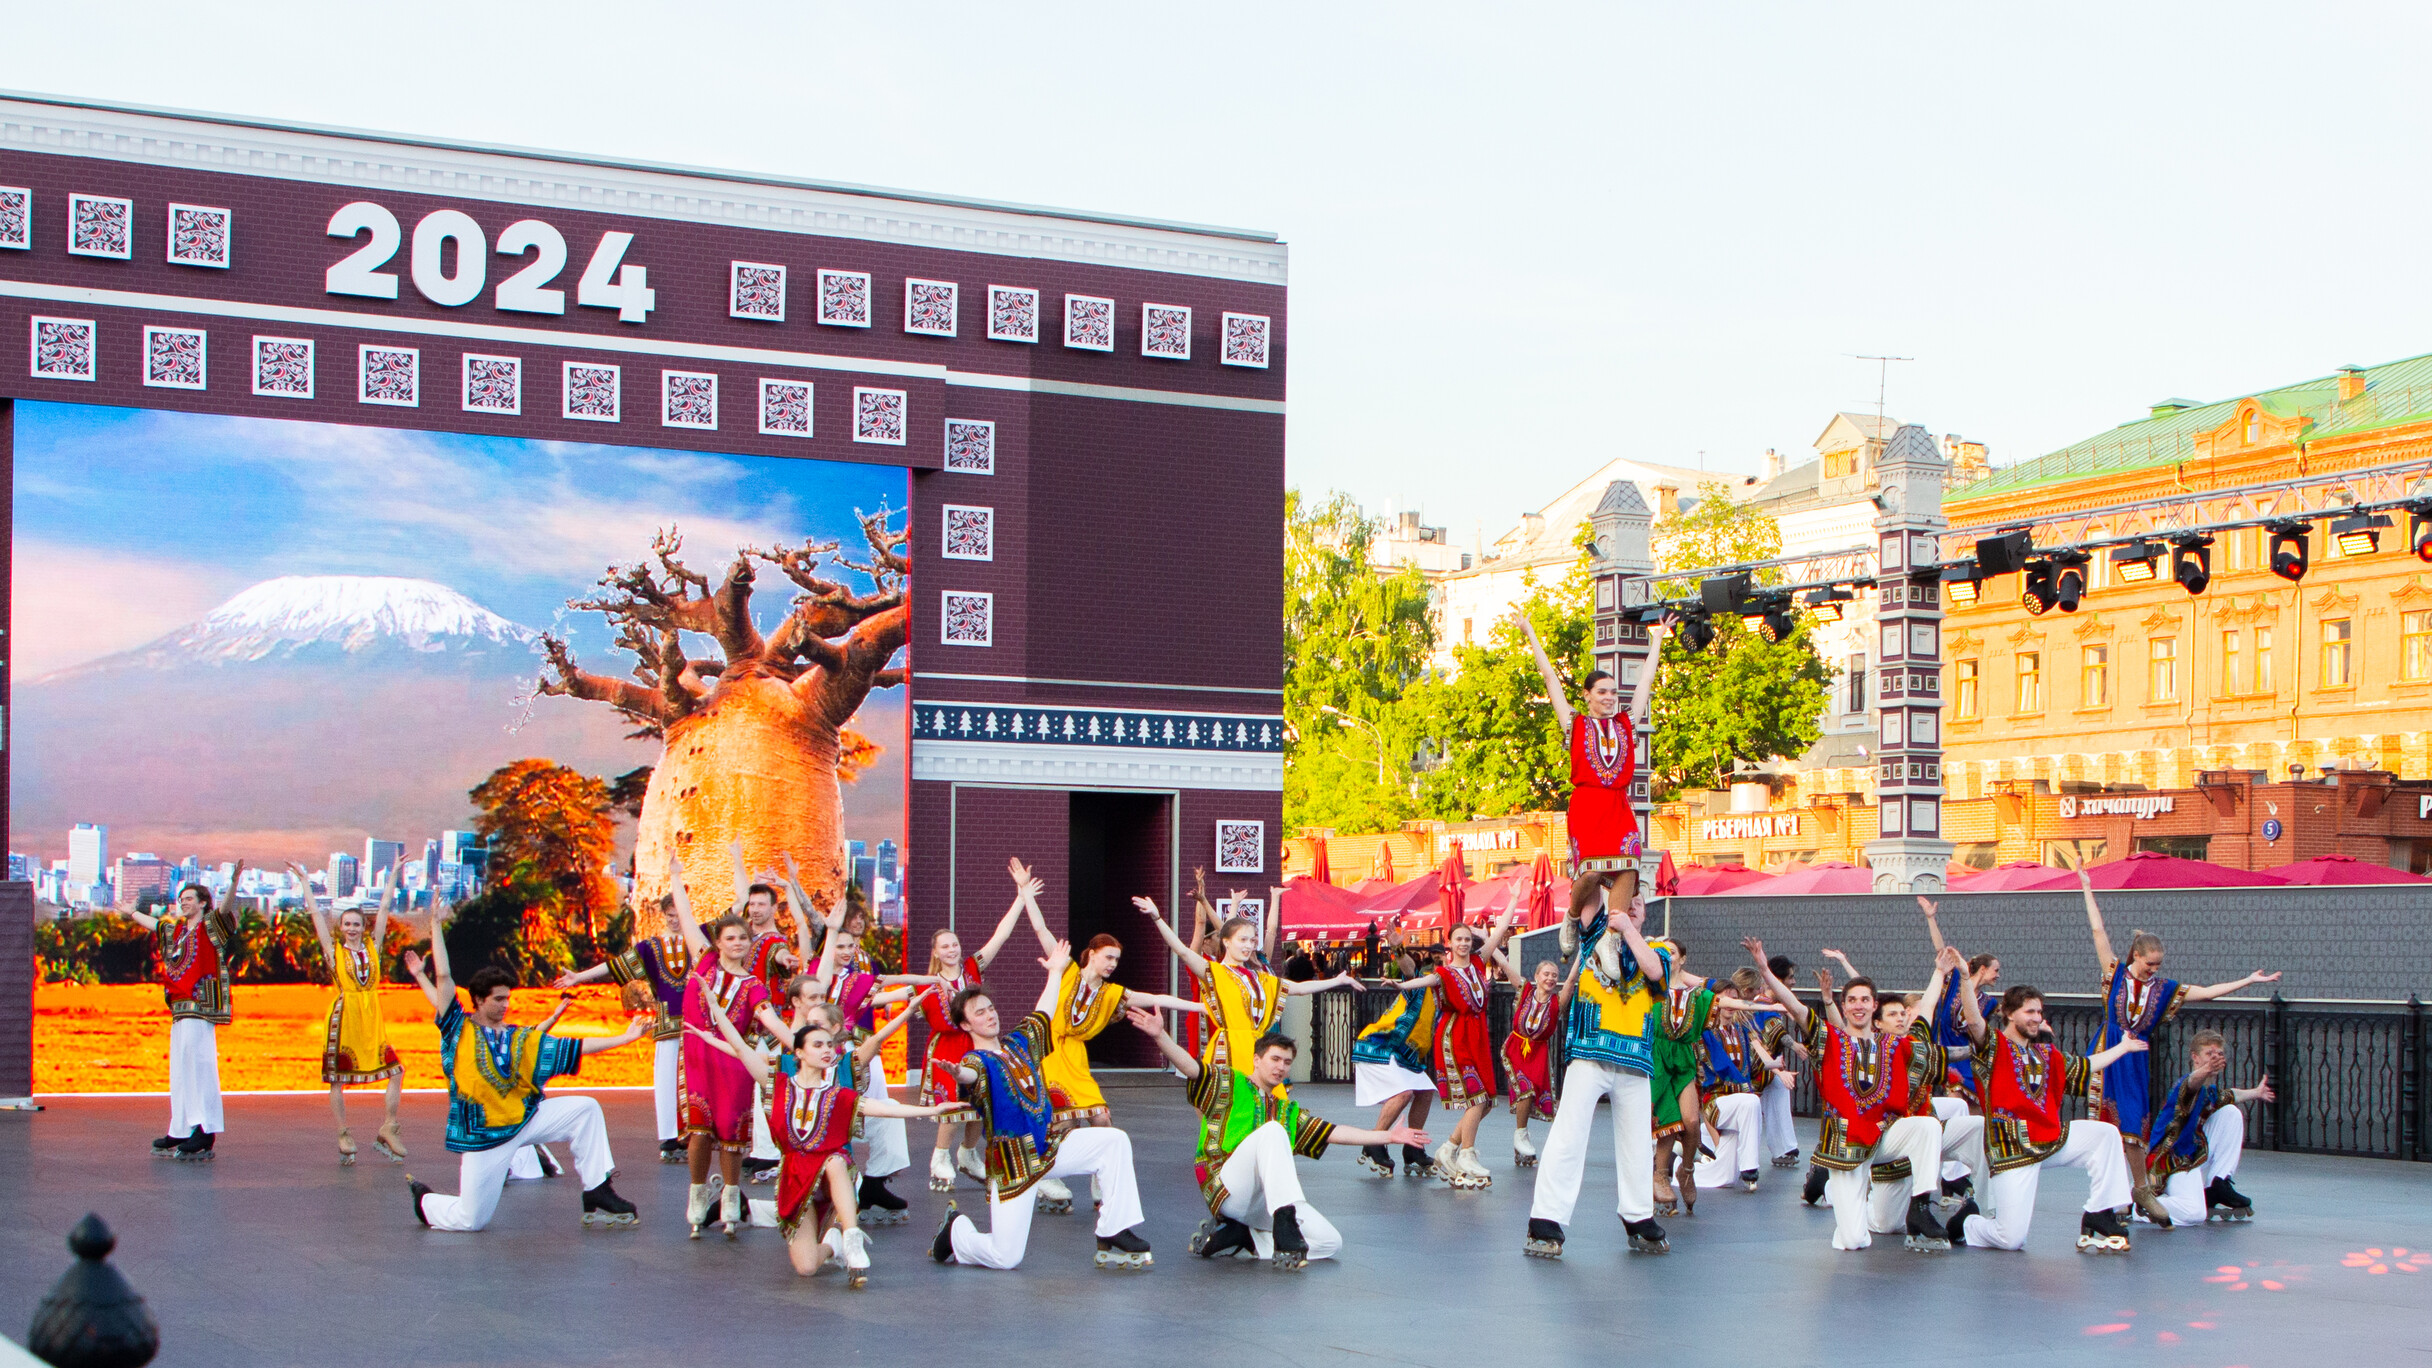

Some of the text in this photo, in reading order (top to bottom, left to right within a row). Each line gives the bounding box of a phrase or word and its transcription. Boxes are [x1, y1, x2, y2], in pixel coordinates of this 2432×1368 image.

[326, 201, 656, 324] 2024
[2080, 796, 2175, 819] хачапури
[1703, 816, 1773, 840] РЕБЕРНАЯ
[2266, 822, 2274, 835] 5
